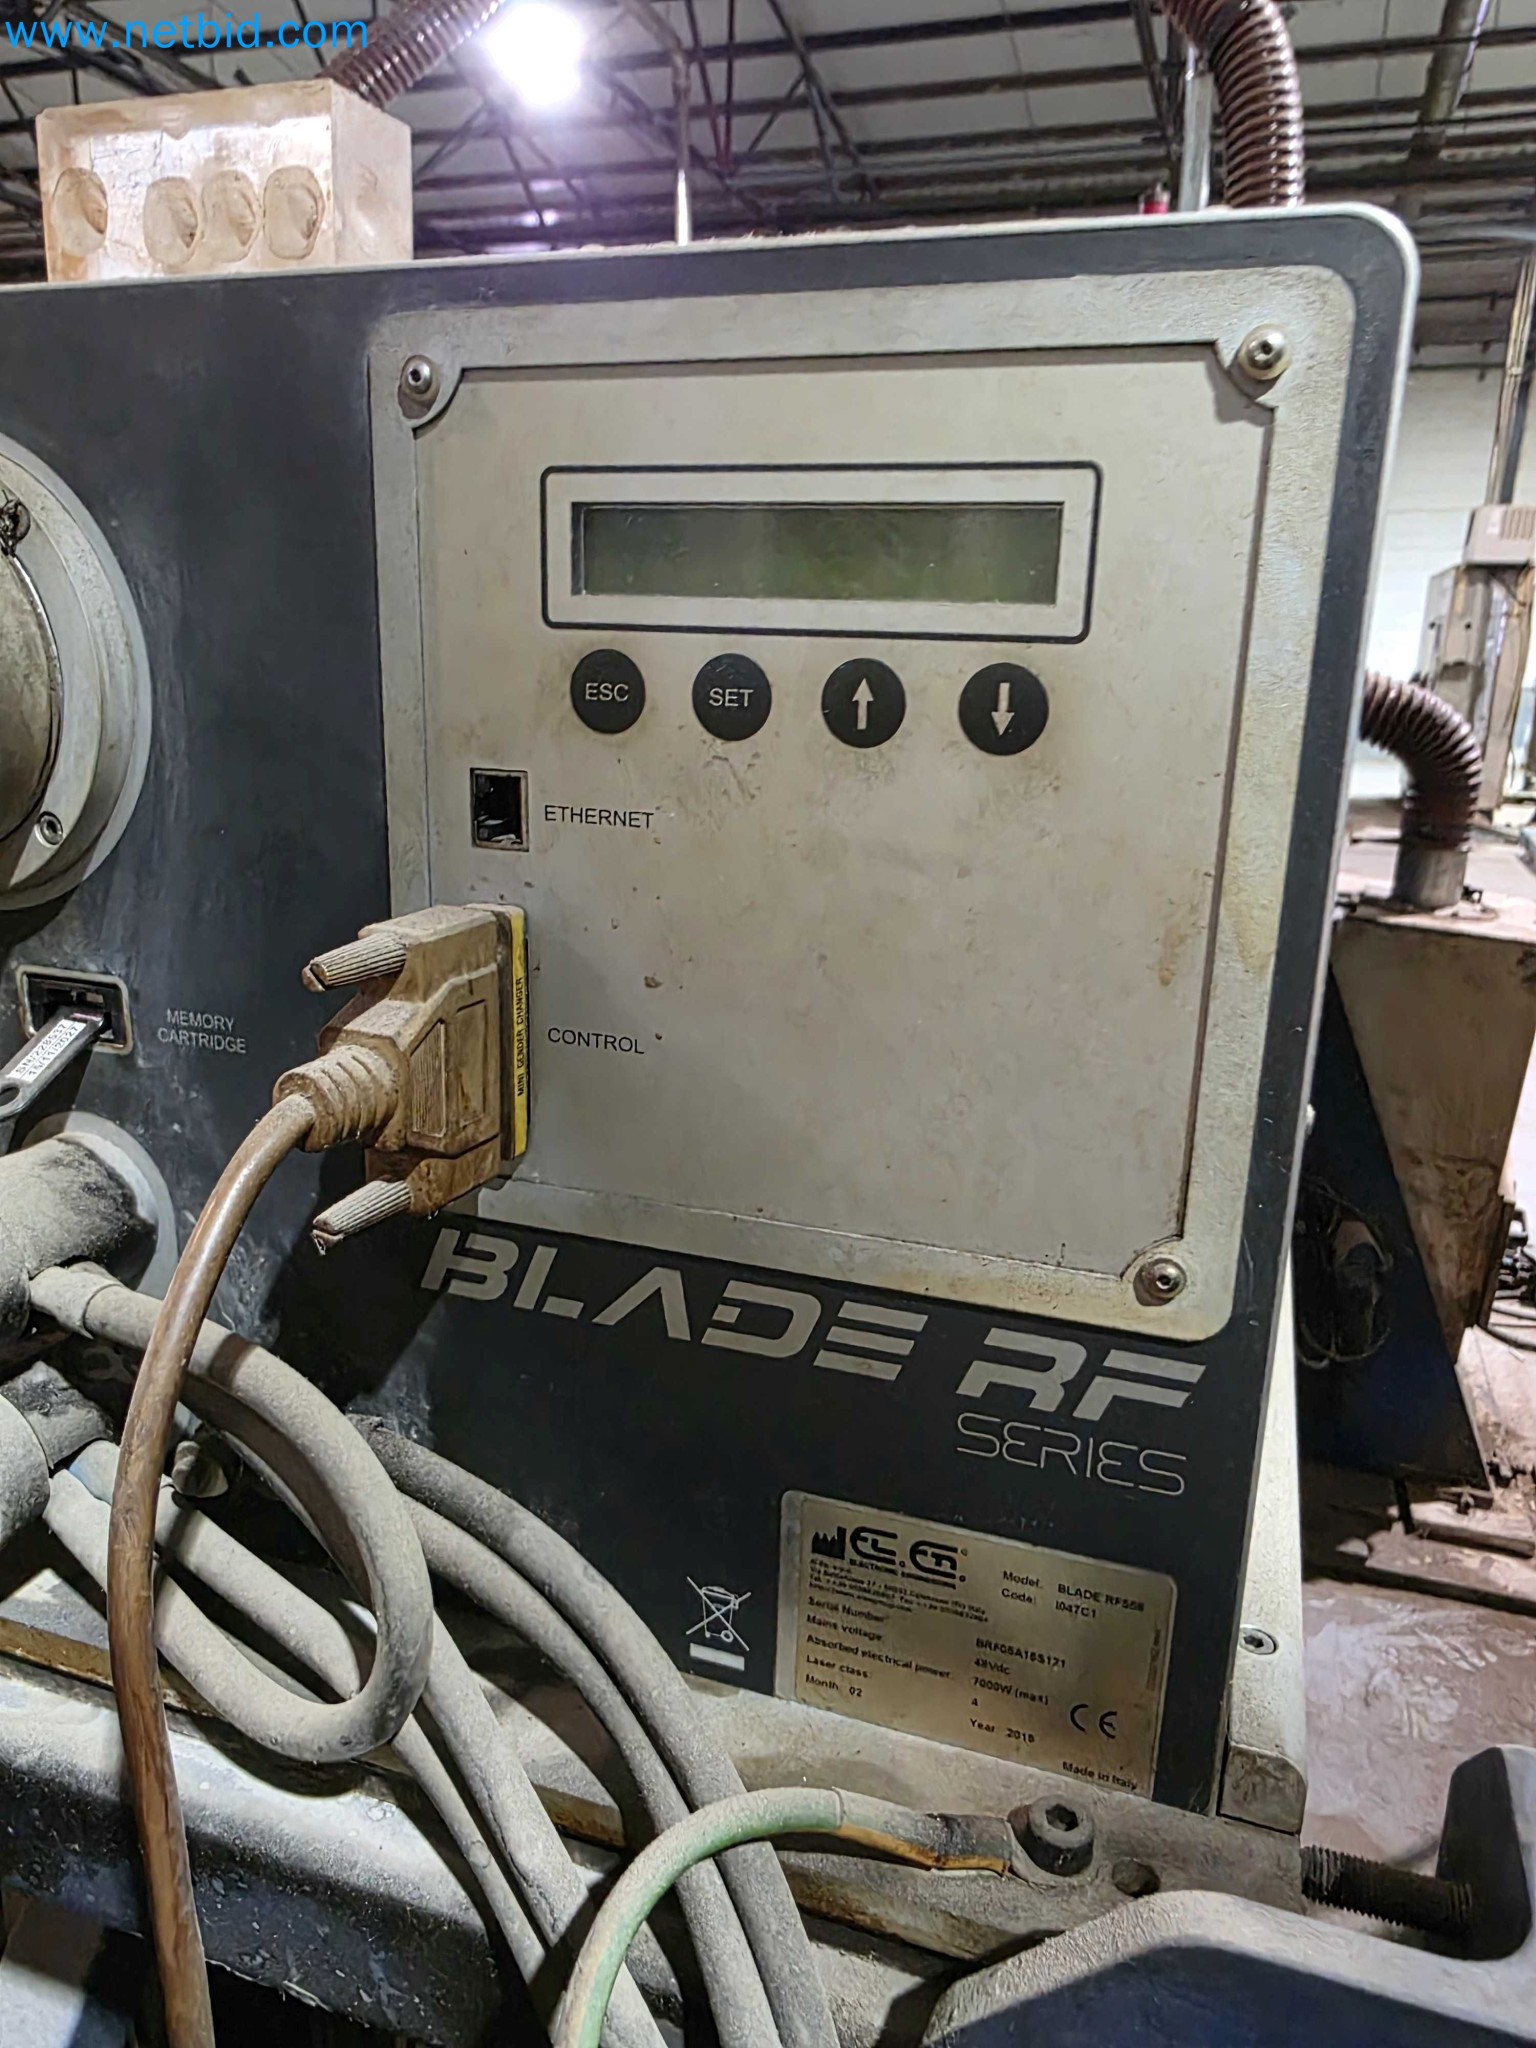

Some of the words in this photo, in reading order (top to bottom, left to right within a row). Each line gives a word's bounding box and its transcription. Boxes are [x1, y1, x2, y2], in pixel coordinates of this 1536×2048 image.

[585, 682, 629, 702] ESC
[708, 687, 754, 707] SET
[544, 804, 654, 829] ETHERNET
[515, 976, 524, 1026] CHANGER
[166, 1007, 235, 1031] MEMORY
[157, 1028, 247, 1054] CARTRIDGE
[516, 1028, 525, 1069] GENDER
[547, 1027, 645, 1054] CONTROL
[420, 1227, 929, 1382] BLADE
[956, 1327, 1207, 1422] RF
[956, 1412, 1187, 1496] SERIES
[1057, 1583, 1101, 1603] BLADE
[806, 1655, 836, 1669] Laser
[861, 1651, 913, 1669] electrical
[849, 1686, 863, 1698] 02
[1069, 1703, 1118, 1739] CE
[1062, 1761, 1095, 1778] Made
[1098, 1772, 1110, 1782] in
[1112, 1774, 1138, 1791] Italy
